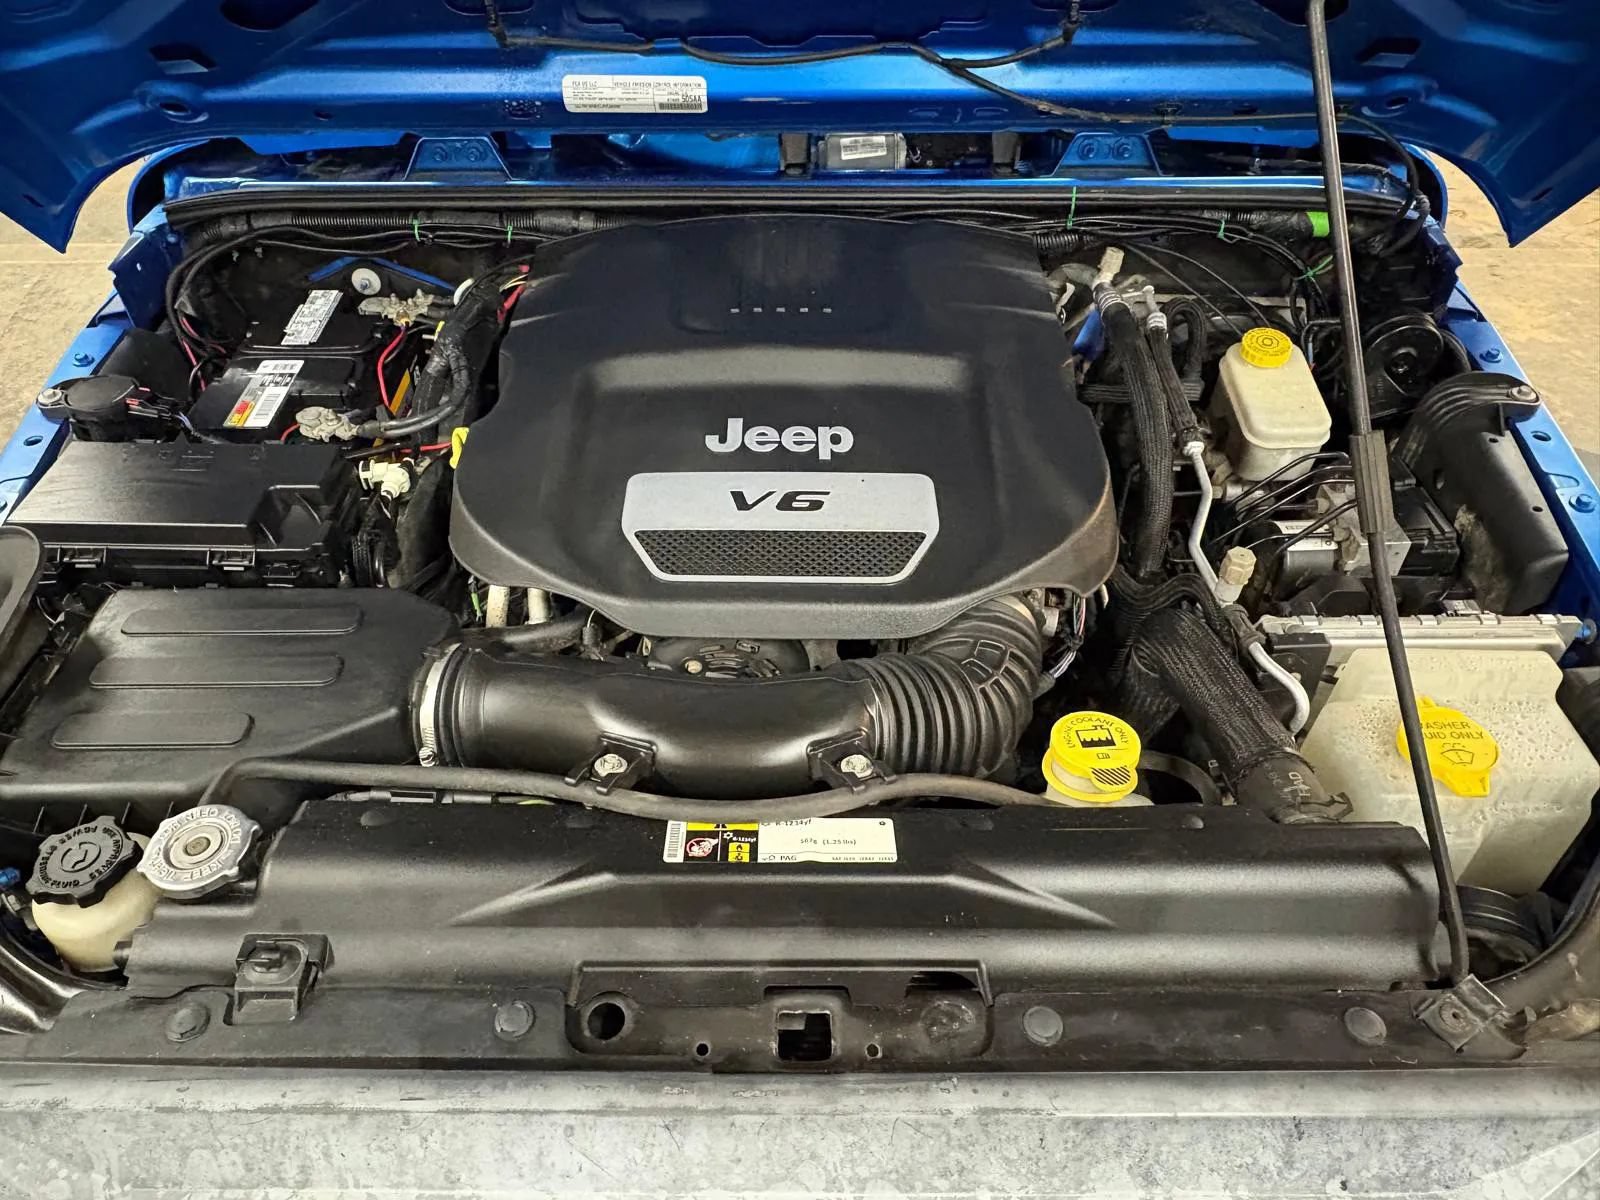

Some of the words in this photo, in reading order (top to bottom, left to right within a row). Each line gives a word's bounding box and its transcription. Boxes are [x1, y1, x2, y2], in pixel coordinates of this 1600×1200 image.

[704, 417, 855, 460] Jeep
[729, 490, 832, 512] V6
[1071, 716, 1115, 728] COOLANT
[1114, 726, 1130, 745] ONLY
[1419, 721, 1472, 730] ASHER
[1423, 731, 1447, 740] UID
[1449, 731, 1485, 740] ONLY
